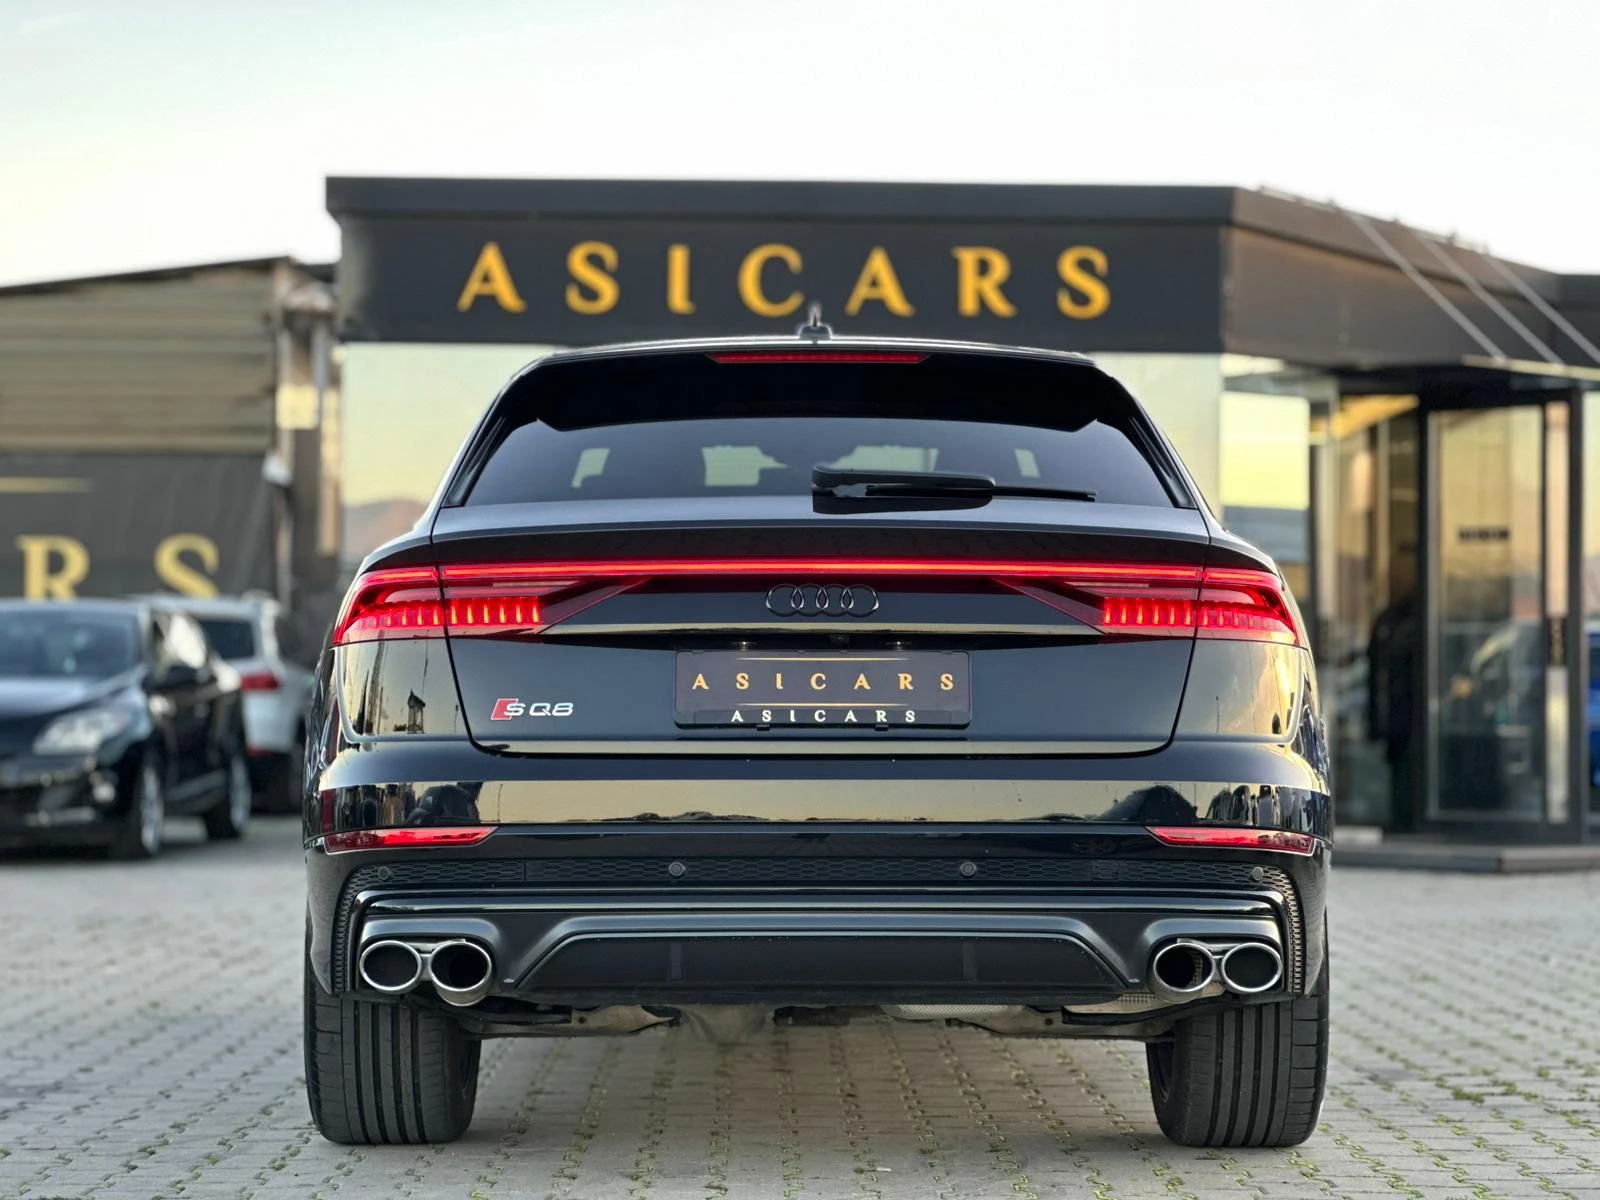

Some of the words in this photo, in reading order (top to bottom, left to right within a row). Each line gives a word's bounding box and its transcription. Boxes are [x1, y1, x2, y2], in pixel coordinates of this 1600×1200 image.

[457, 240, 1111, 319] ASICARS
[692, 672, 954, 690] ASICARS
[731, 708, 916, 723] ASICARS
